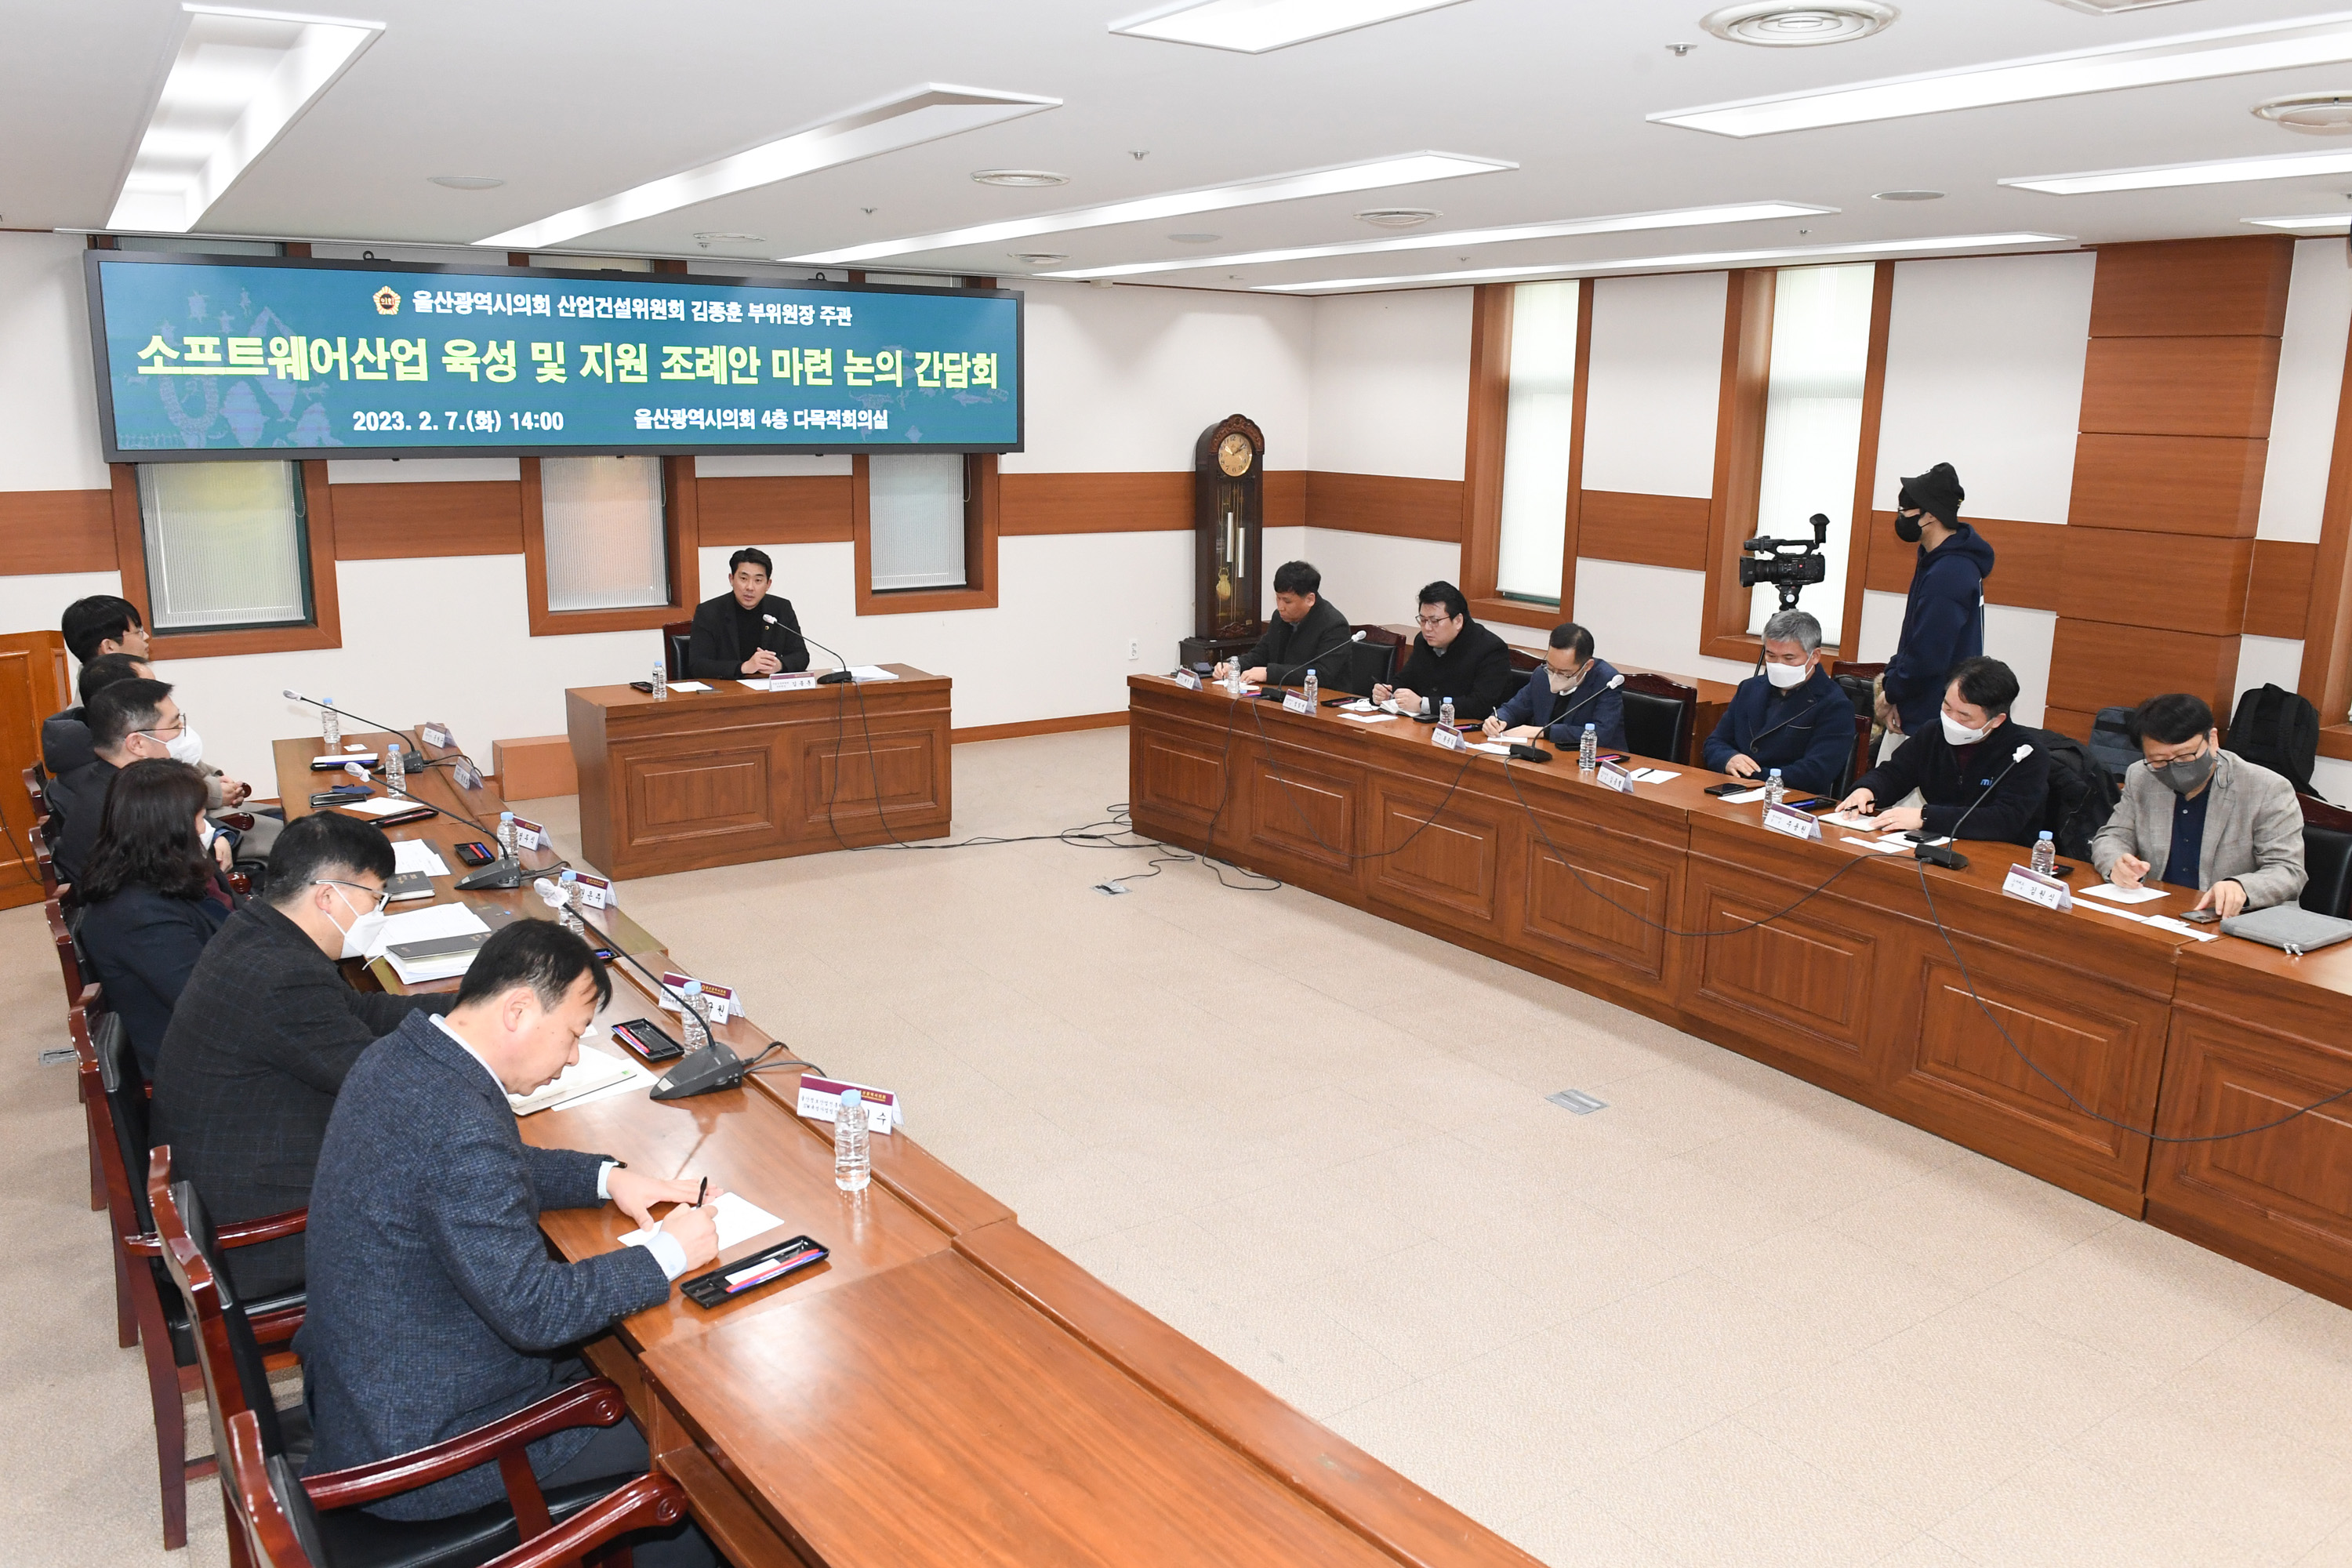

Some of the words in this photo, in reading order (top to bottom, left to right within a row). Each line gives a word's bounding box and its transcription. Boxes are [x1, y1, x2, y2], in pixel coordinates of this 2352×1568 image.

[412, 290, 551, 317] 울산광역시의회
[557, 295, 685, 321] 산업건설위원회
[691, 300, 743, 323] 김종훈
[747, 303, 815, 326] 부위원장
[819, 306, 853, 327] 주관
[136, 335, 428, 381] 소프트웨어산업
[441, 339, 517, 383] 육성
[531, 341, 568, 383] 및
[579, 342, 648, 383] 지원
[660, 345, 761, 385] 조례안
[771, 347, 833, 386] 마련
[843, 349, 902, 387] 논의
[914, 351, 998, 389] 간담회
[352, 411, 412, 431] 2023.
[419, 411, 438, 430] 2.
[445, 409, 502, 433] 7.(화)
[510, 411, 564, 430] 14:00
[633, 408, 756, 430] 울산광역시의회
[760, 408, 789, 430] 4층
[793, 408, 888, 430] 다목적회의실
